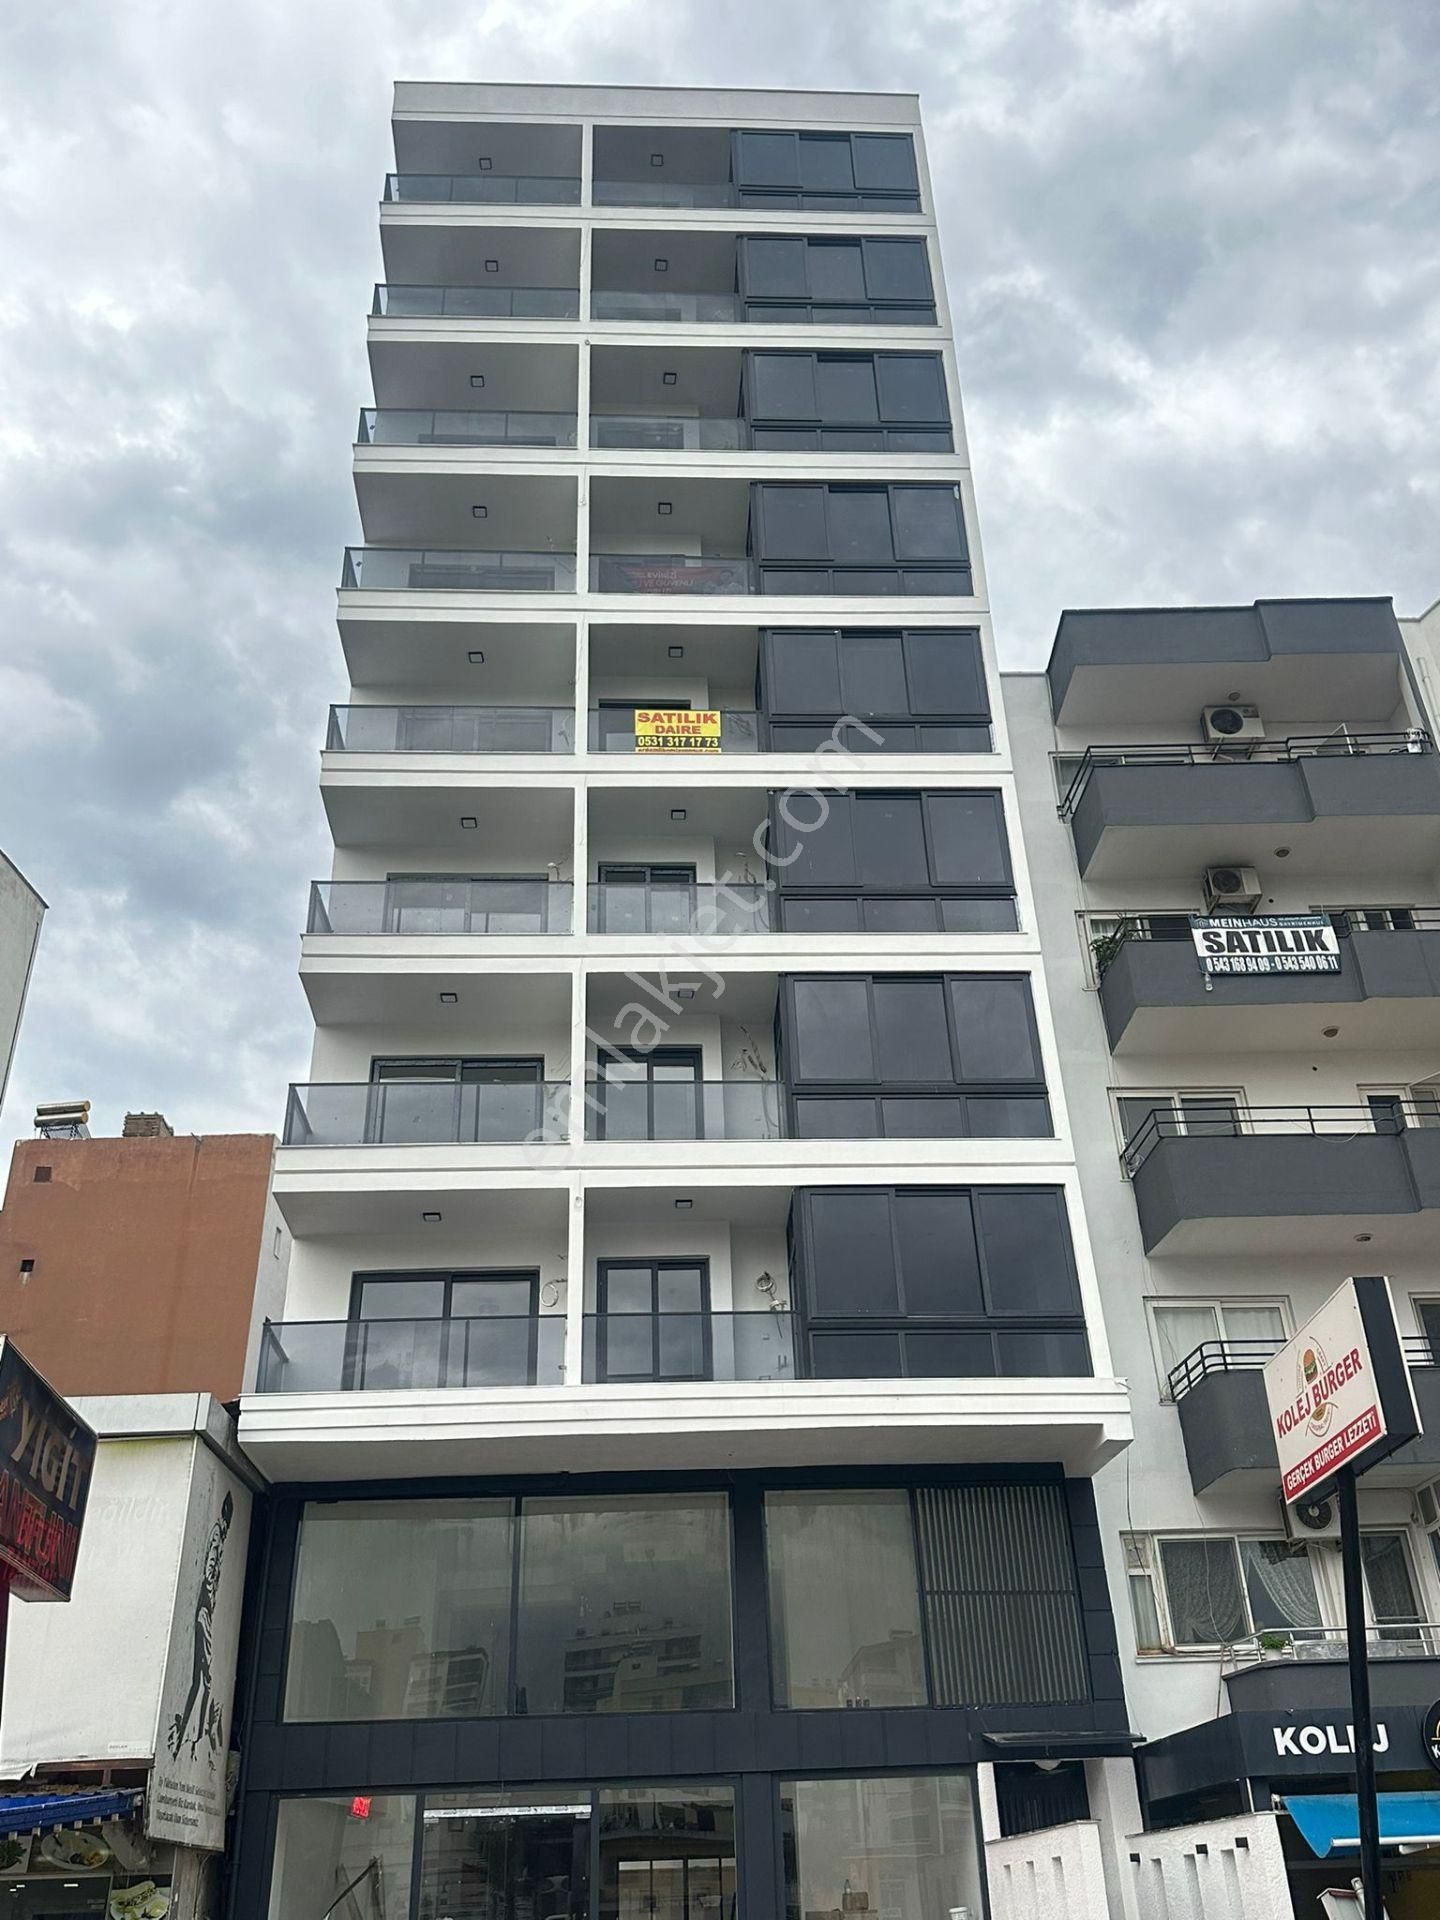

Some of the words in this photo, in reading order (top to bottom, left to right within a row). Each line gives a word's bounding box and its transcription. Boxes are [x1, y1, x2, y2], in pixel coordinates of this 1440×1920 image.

[637, 712, 717, 724] SATILIK
[638, 736, 664, 746] 0531
[666, 737, 686, 746] 317
[689, 737, 703, 747] 17
[706, 737, 719, 747] 73
[1210, 917, 1278, 928] MEINHAUS
[1202, 928, 1331, 954] SATILIK
[1213, 956, 1230, 972] 543
[1230, 956, 1246, 972] 168
[1246, 956, 1258, 972] 94
[1258, 956, 1270, 972] 09
[1282, 955, 1299, 971] 543
[1299, 955, 1316, 970] 540
[1316, 954, 1328, 970] 06
[1328, 954, 1339, 969] 11
[1276, 1394, 1312, 1439] KOLEJ
[1314, 1347, 1363, 1409] BURGER
[1286, 1461, 1315, 1491] GERÇEK
[1314, 1438, 1345, 1474] BURGER
